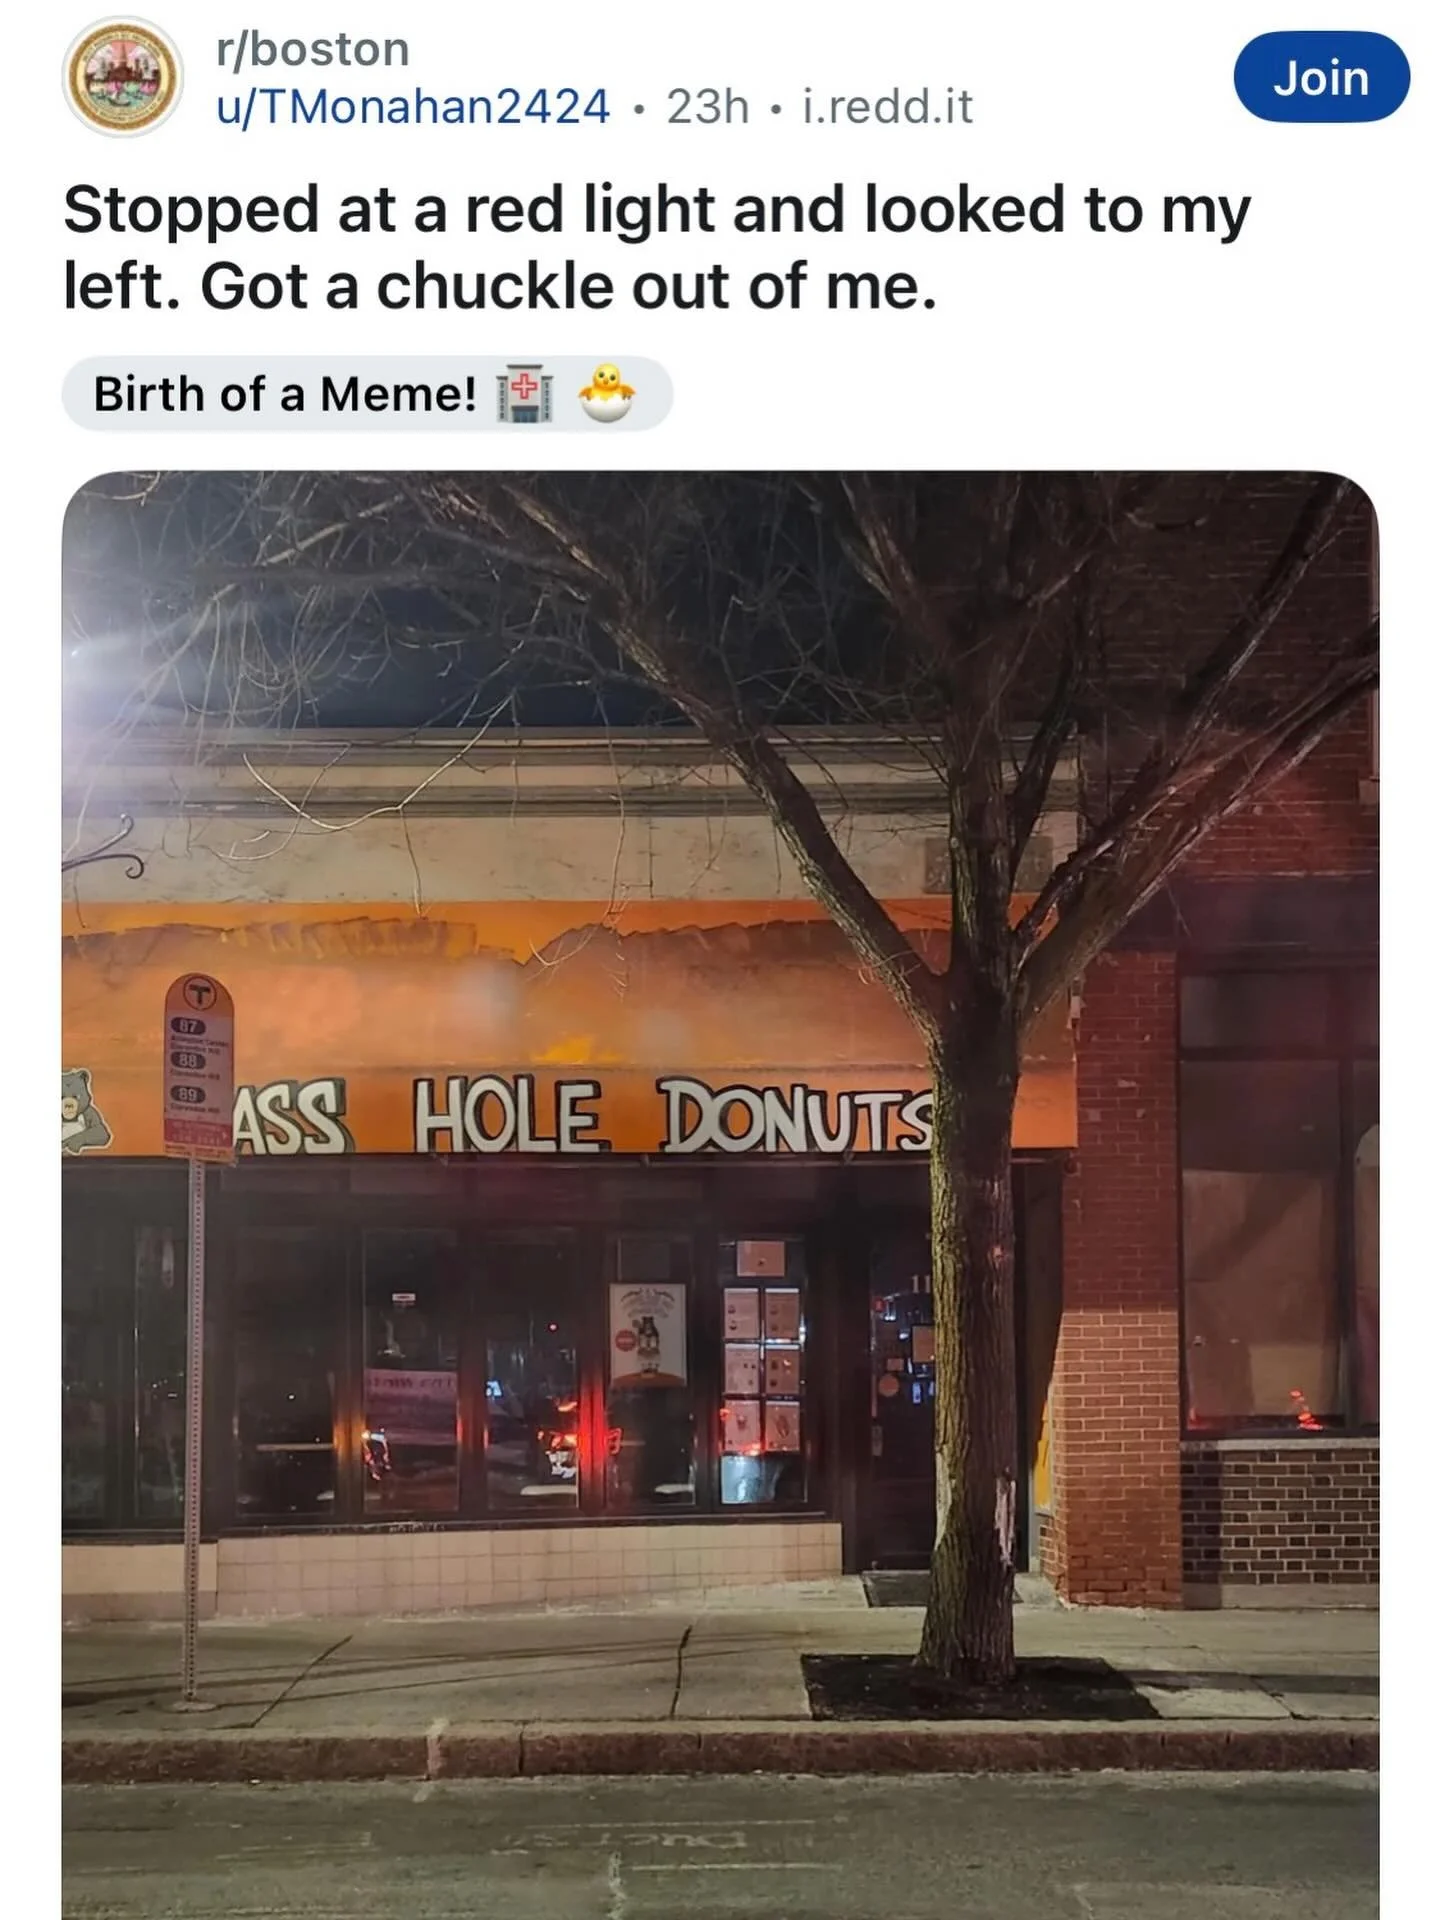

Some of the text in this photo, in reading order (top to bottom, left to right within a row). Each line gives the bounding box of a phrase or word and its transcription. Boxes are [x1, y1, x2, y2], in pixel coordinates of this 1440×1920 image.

[189, 984, 211, 1005] T
[179, 1019, 198, 1033] 87
[179, 1053, 197, 1068] 88
[179, 1087, 197, 1101] 89
[413, 1074, 611, 1154] HOLE
[657, 1076, 936, 1154] DONUTS
